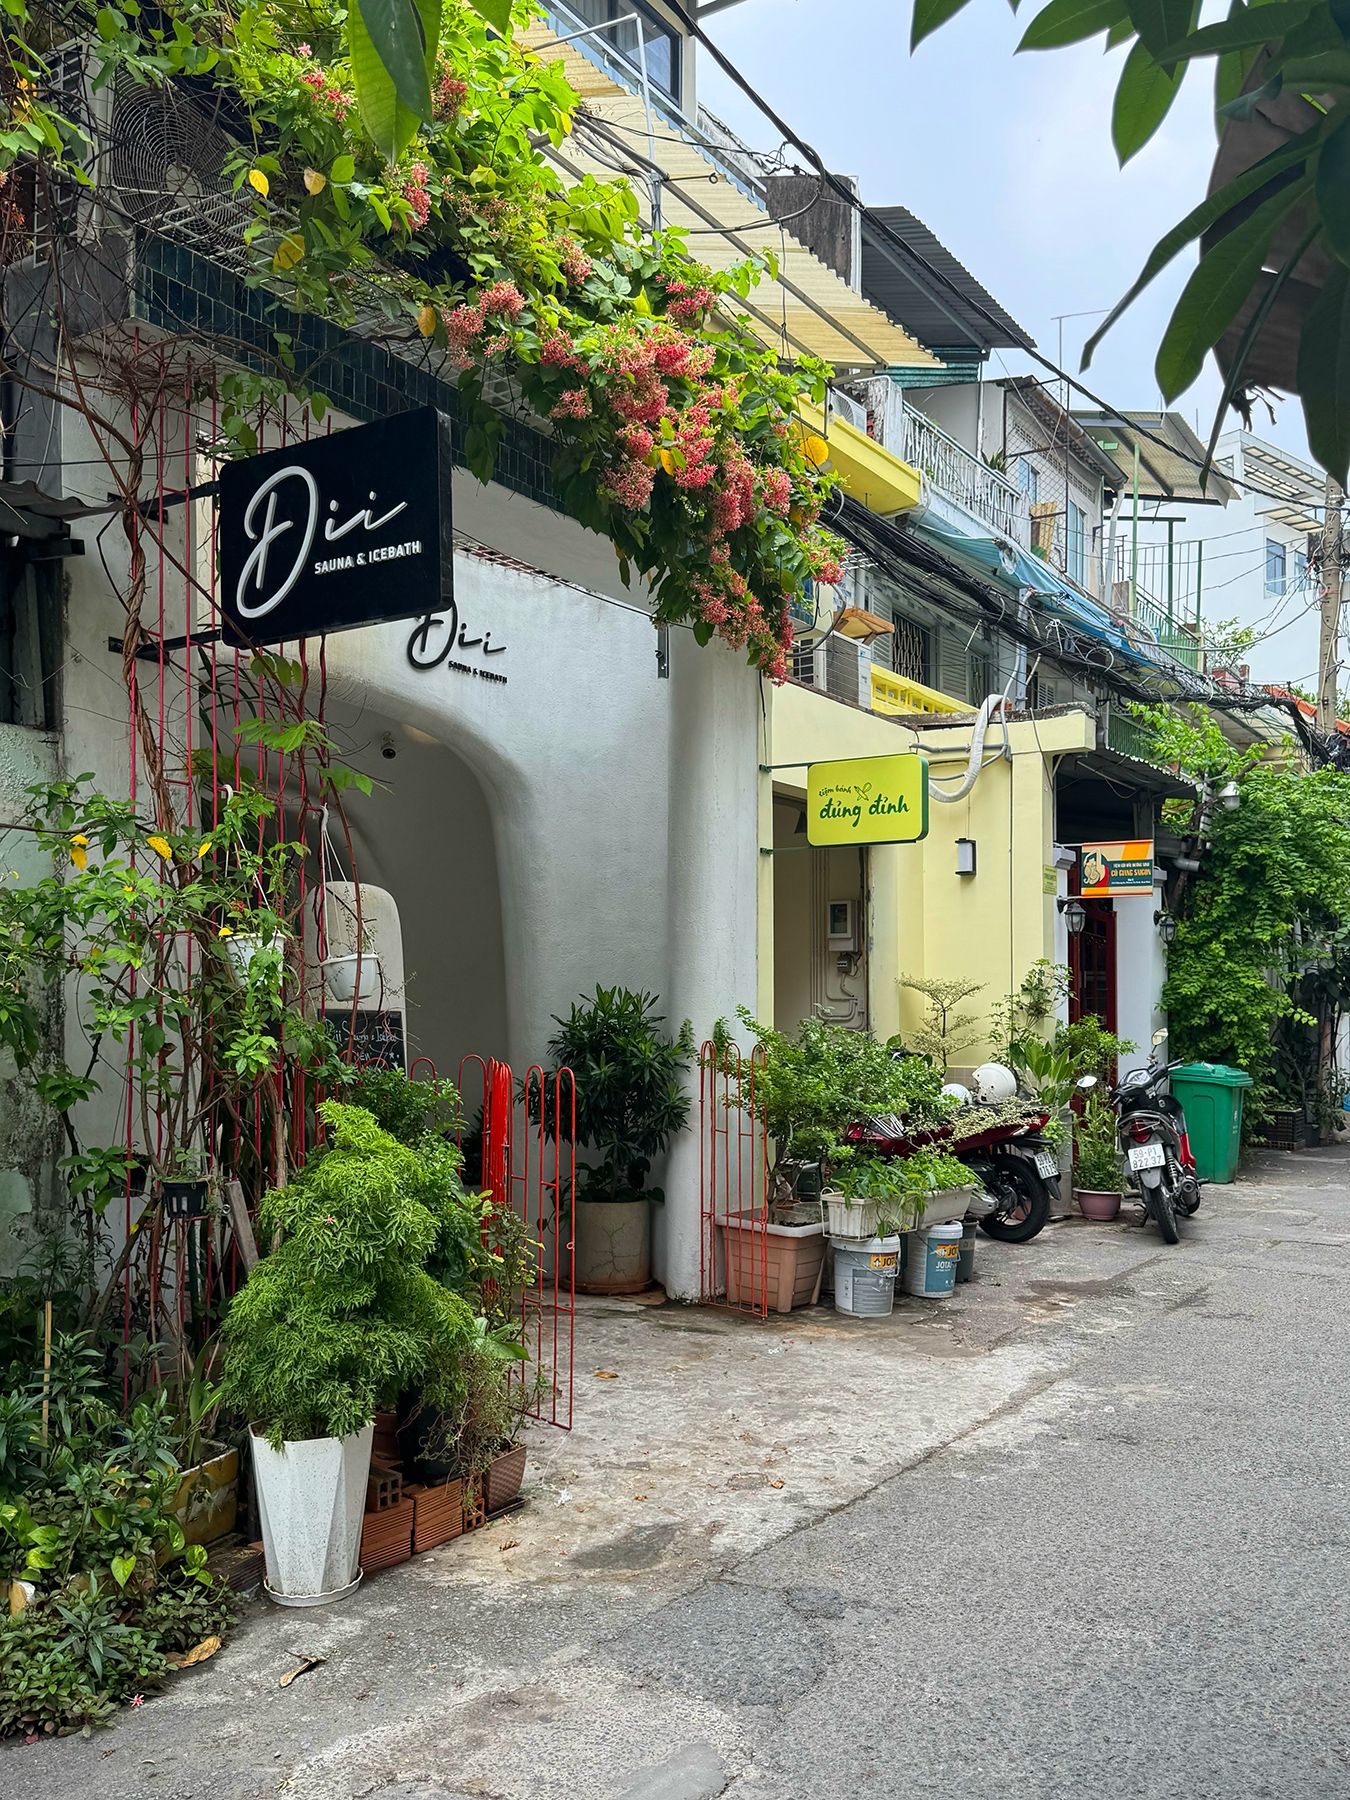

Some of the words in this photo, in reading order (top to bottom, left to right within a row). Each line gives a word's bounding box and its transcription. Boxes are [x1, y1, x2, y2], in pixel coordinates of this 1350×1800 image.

[314, 555, 355, 576] SAUNA
[356, 553, 366, 565] &
[368, 540, 422, 564] ICEBATH
[447, 660, 472, 674] SAUNA
[479, 669, 508, 685] ICEBATH
[819, 797, 862, 828] đủng
[868, 793, 911, 815] đỉnh
